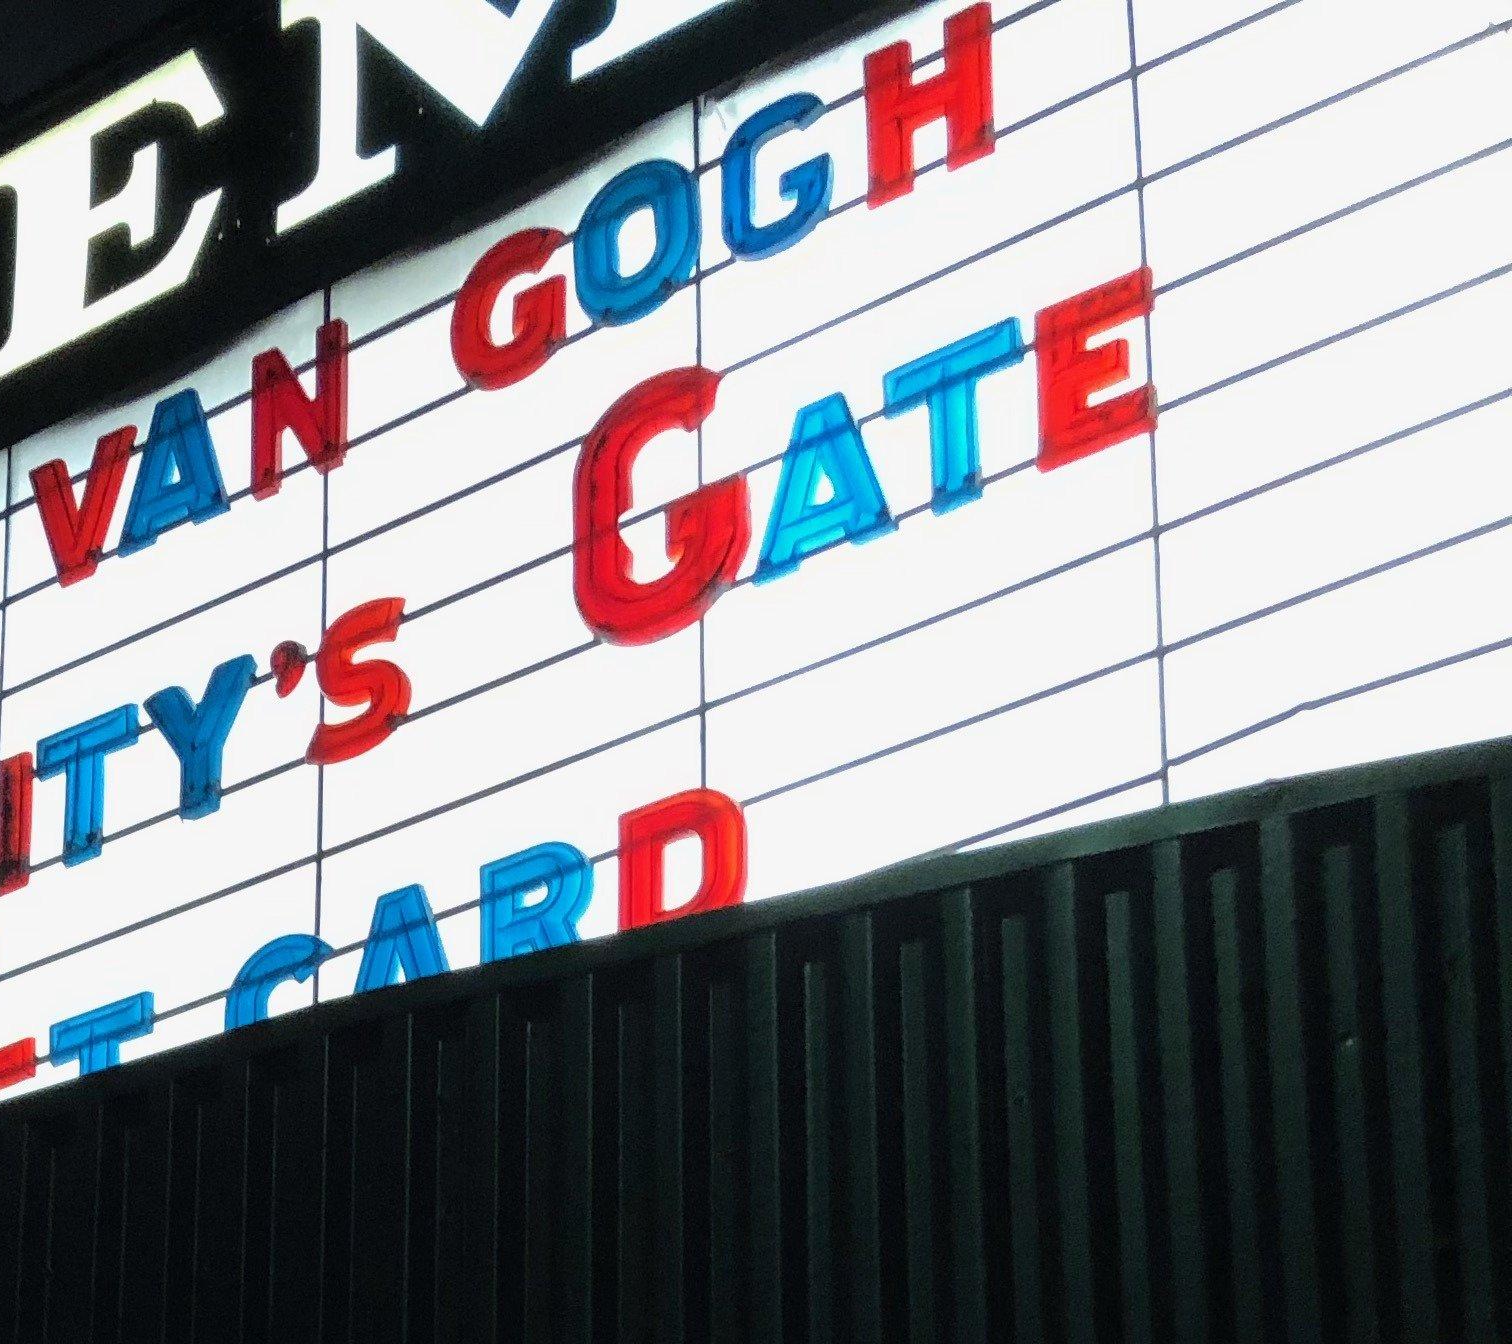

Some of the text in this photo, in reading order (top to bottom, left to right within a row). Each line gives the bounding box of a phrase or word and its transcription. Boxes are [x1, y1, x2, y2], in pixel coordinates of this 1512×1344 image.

[29, 319, 348, 588] VAN
[450, 2, 996, 389] GOGH
[573, 265, 1157, 647] GATE
